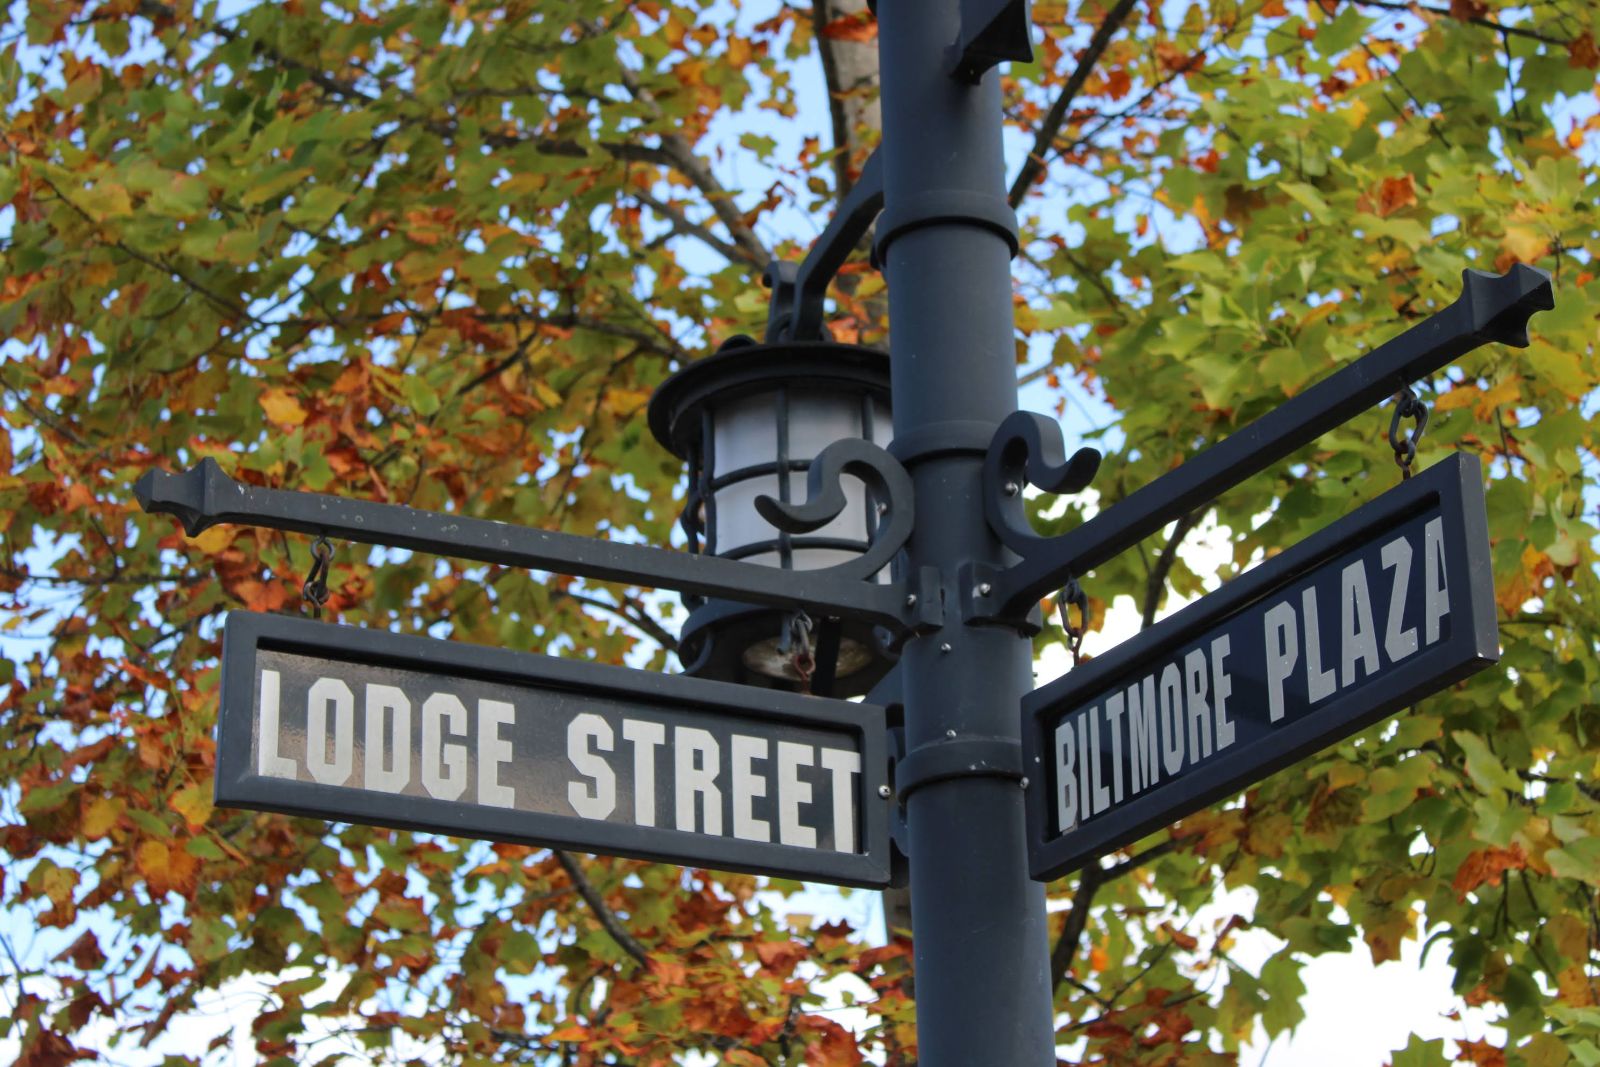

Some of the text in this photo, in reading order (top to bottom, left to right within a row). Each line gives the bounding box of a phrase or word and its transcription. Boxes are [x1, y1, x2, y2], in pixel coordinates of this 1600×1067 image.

[258, 669, 861, 854] LODGE STREET
[1054, 516, 1451, 832] BILTMORE PLAZA
